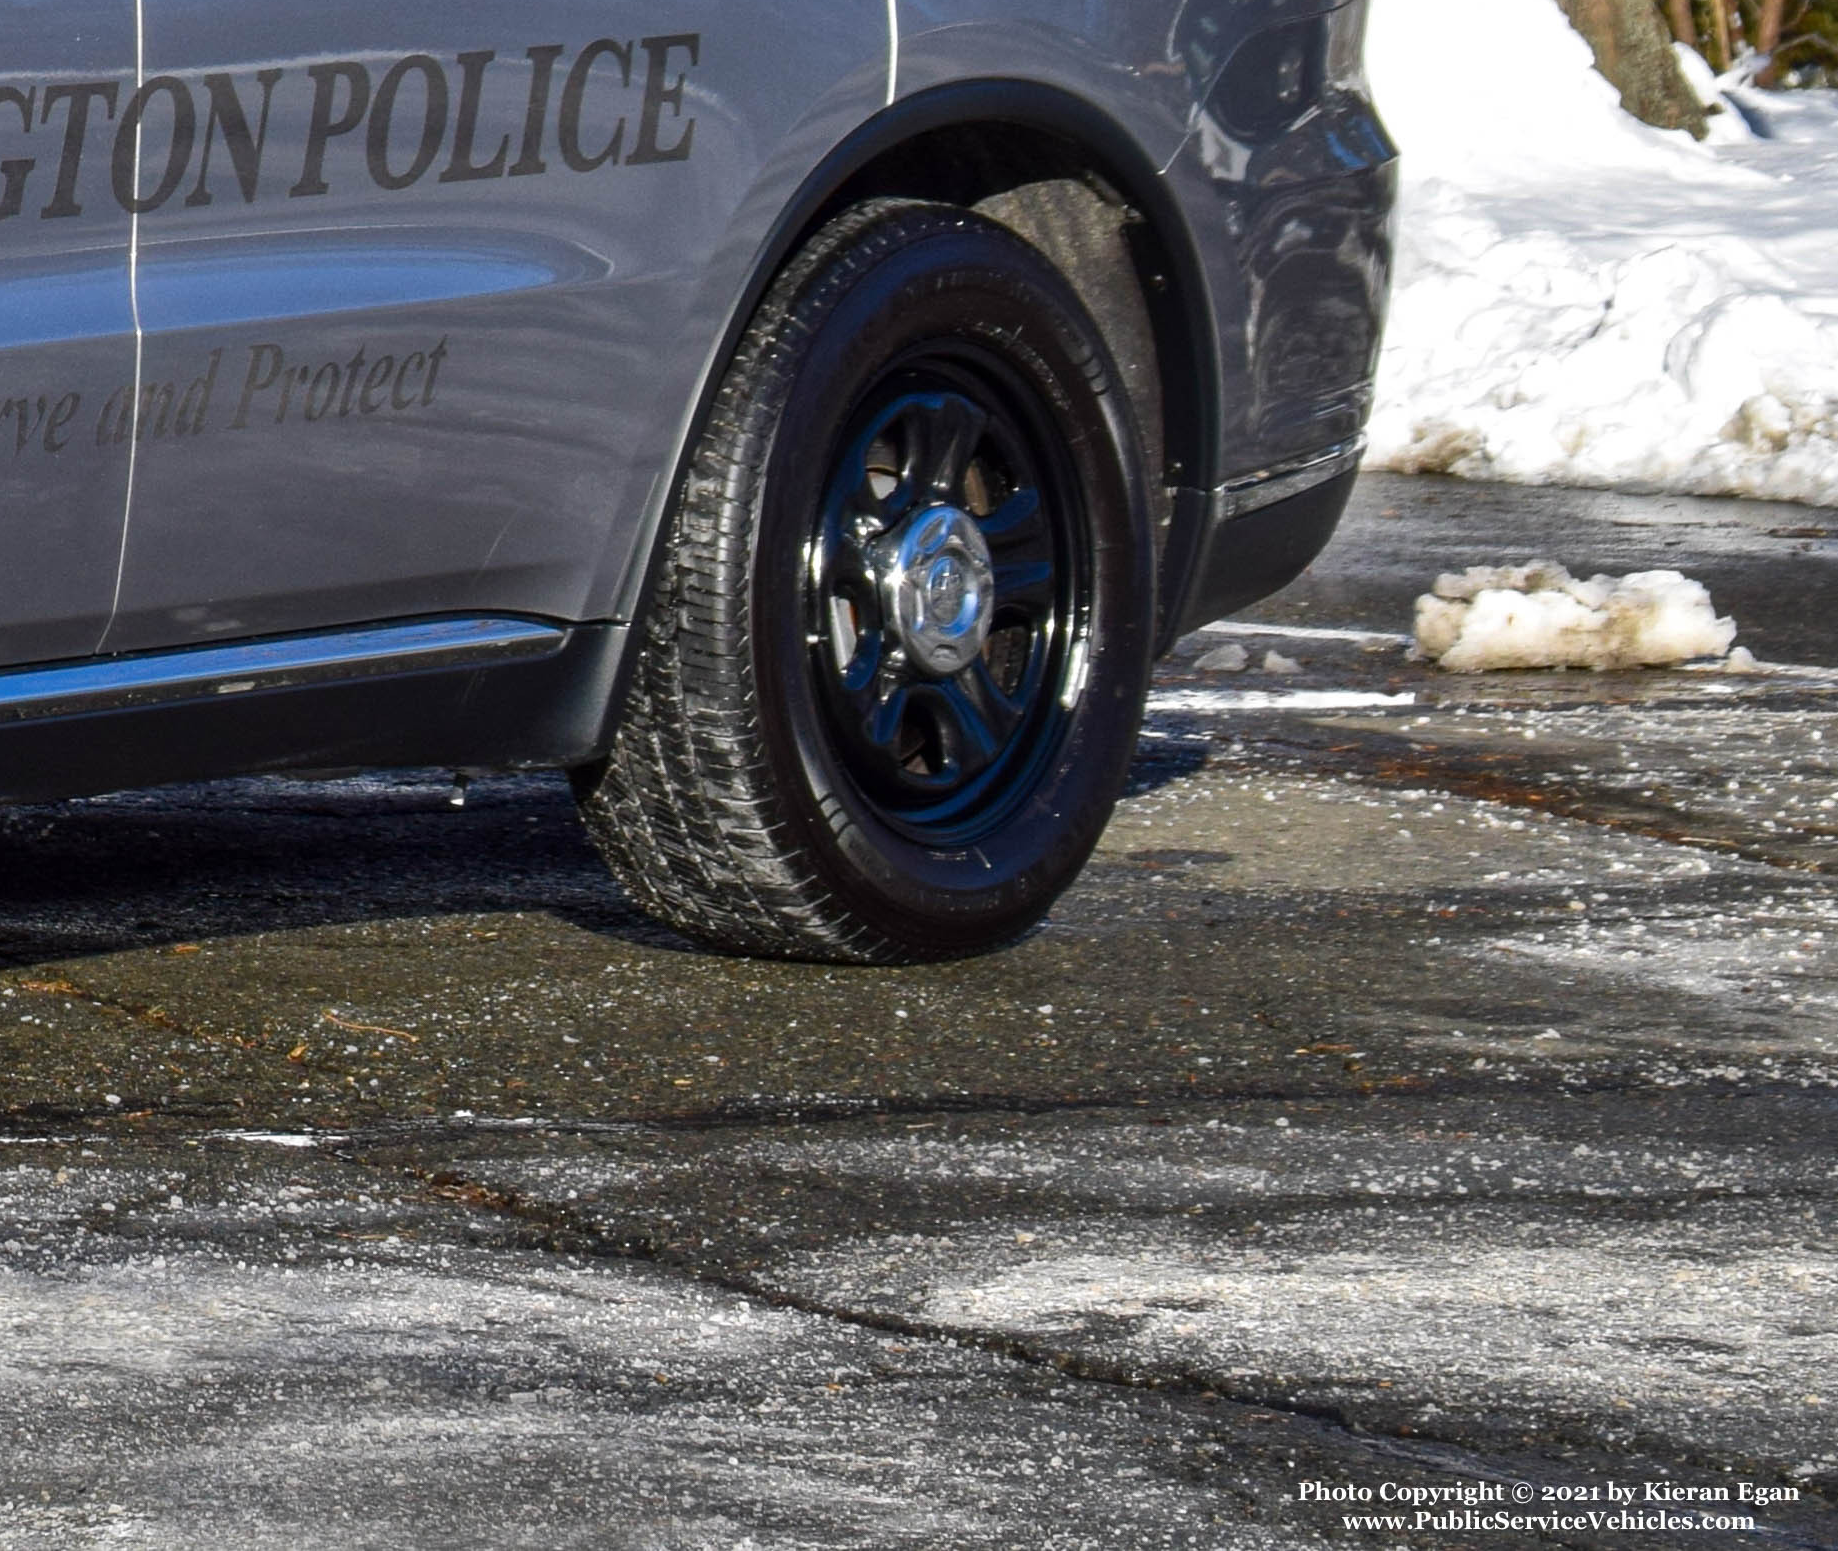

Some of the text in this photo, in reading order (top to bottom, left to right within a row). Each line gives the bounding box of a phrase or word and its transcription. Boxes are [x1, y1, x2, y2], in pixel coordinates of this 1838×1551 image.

[289, 32, 702, 198] POLICE
[99, 347, 222, 448] and
[227, 334, 448, 433] Protect
